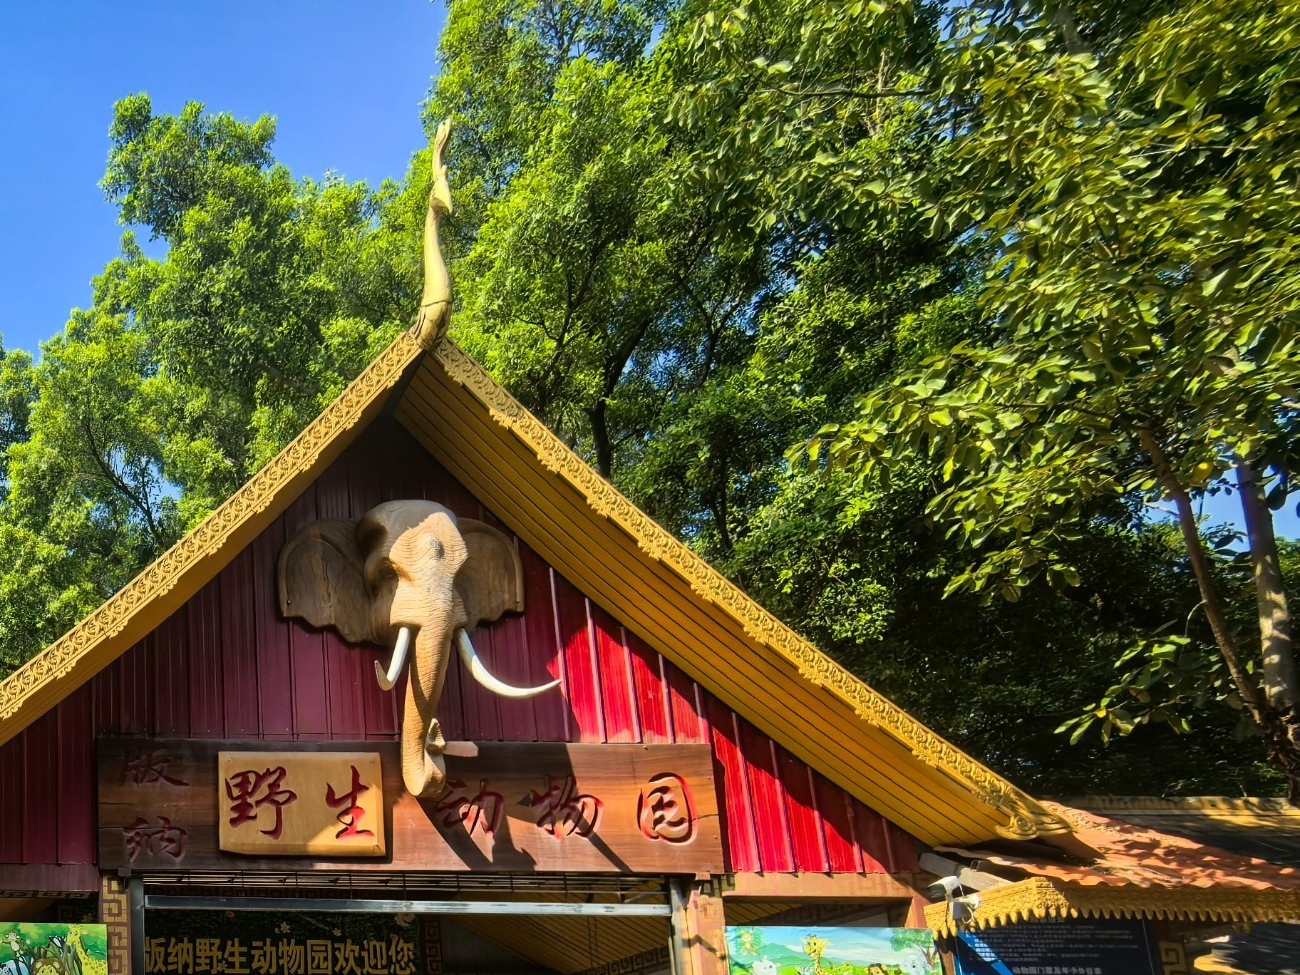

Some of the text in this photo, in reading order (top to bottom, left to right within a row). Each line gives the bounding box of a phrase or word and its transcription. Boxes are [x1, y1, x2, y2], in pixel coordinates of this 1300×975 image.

[224, 764, 374, 841] 野生
[436, 772, 699, 846] 动物园
